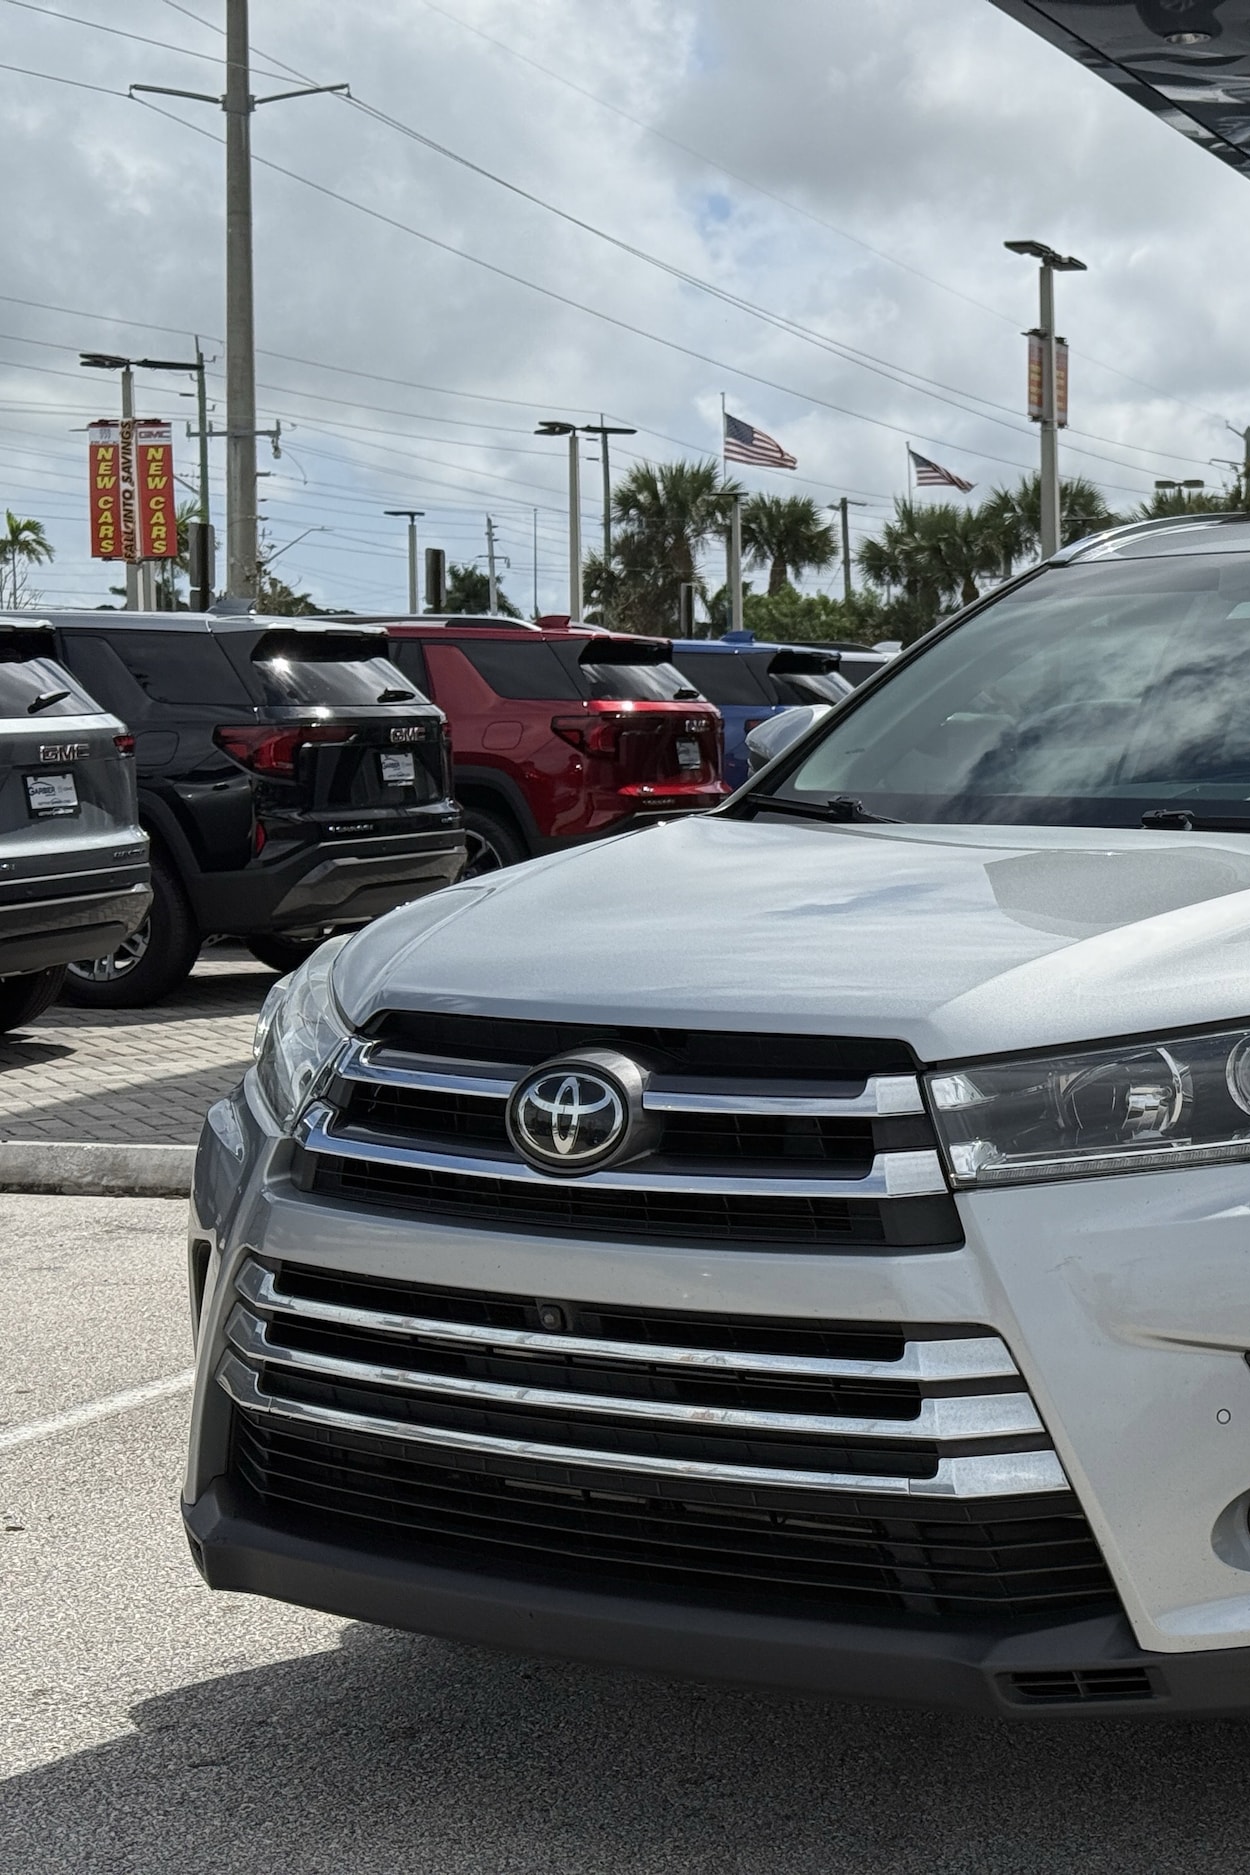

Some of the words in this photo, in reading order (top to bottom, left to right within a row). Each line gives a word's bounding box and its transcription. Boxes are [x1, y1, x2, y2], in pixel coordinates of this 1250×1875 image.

[121, 420, 133, 484] SAVINGS
[139, 430, 171, 439] GMC
[97, 447, 117, 490] NEW
[146, 447, 168, 490] NEW
[97, 495, 115, 553] CARS
[122, 489, 134, 524] INTO
[149, 495, 167, 554] CARS
[124, 529, 135, 560] FALL
[40, 743, 90, 762] GMC
[390, 727, 426, 743] GMC
